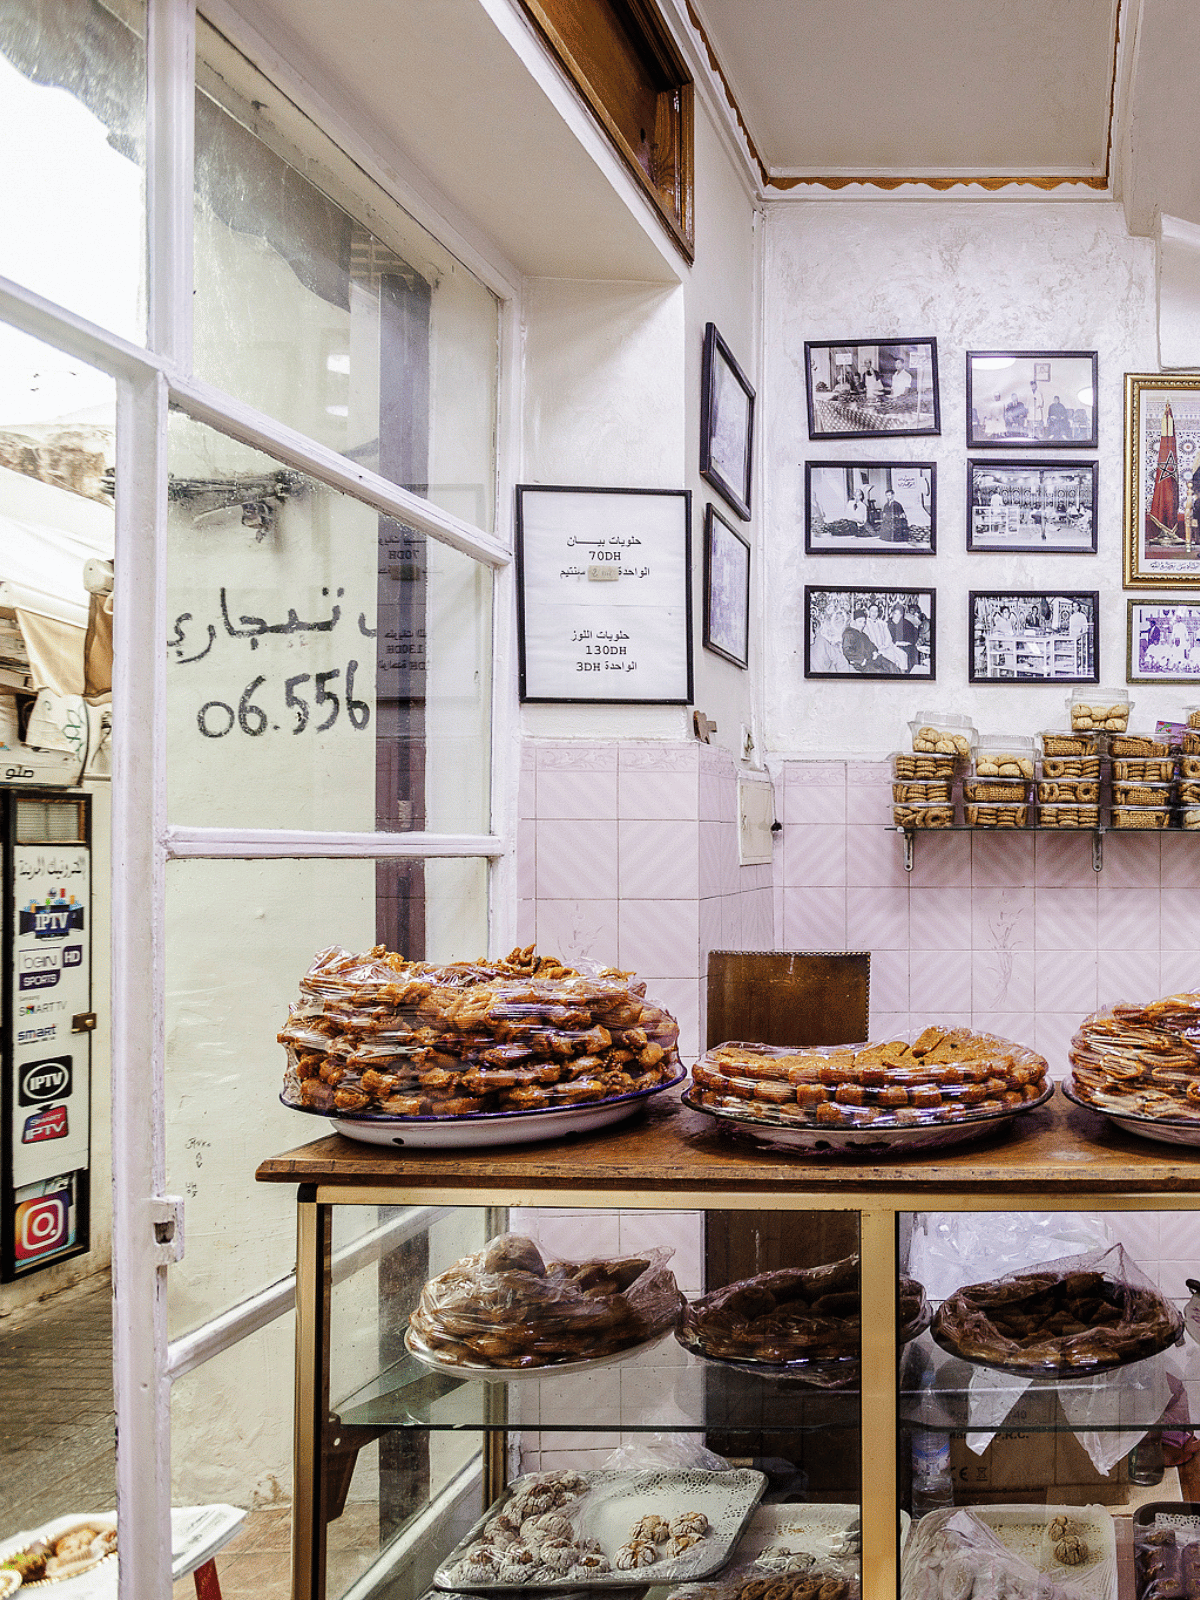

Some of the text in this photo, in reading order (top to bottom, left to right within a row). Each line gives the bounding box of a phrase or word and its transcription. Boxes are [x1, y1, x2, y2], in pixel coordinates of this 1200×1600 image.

[588, 550, 622, 561] 70DH
[571, 629, 593, 642] اللوز
[585, 645, 627, 655] 130DH
[576, 660, 637, 673] الواحدة 3DH
[34, 912, 69, 931] IPTV
[64, 950, 80, 964] HD
[23, 973, 58, 987] SPORTS
[29, 1071, 63, 1091] IPTV
